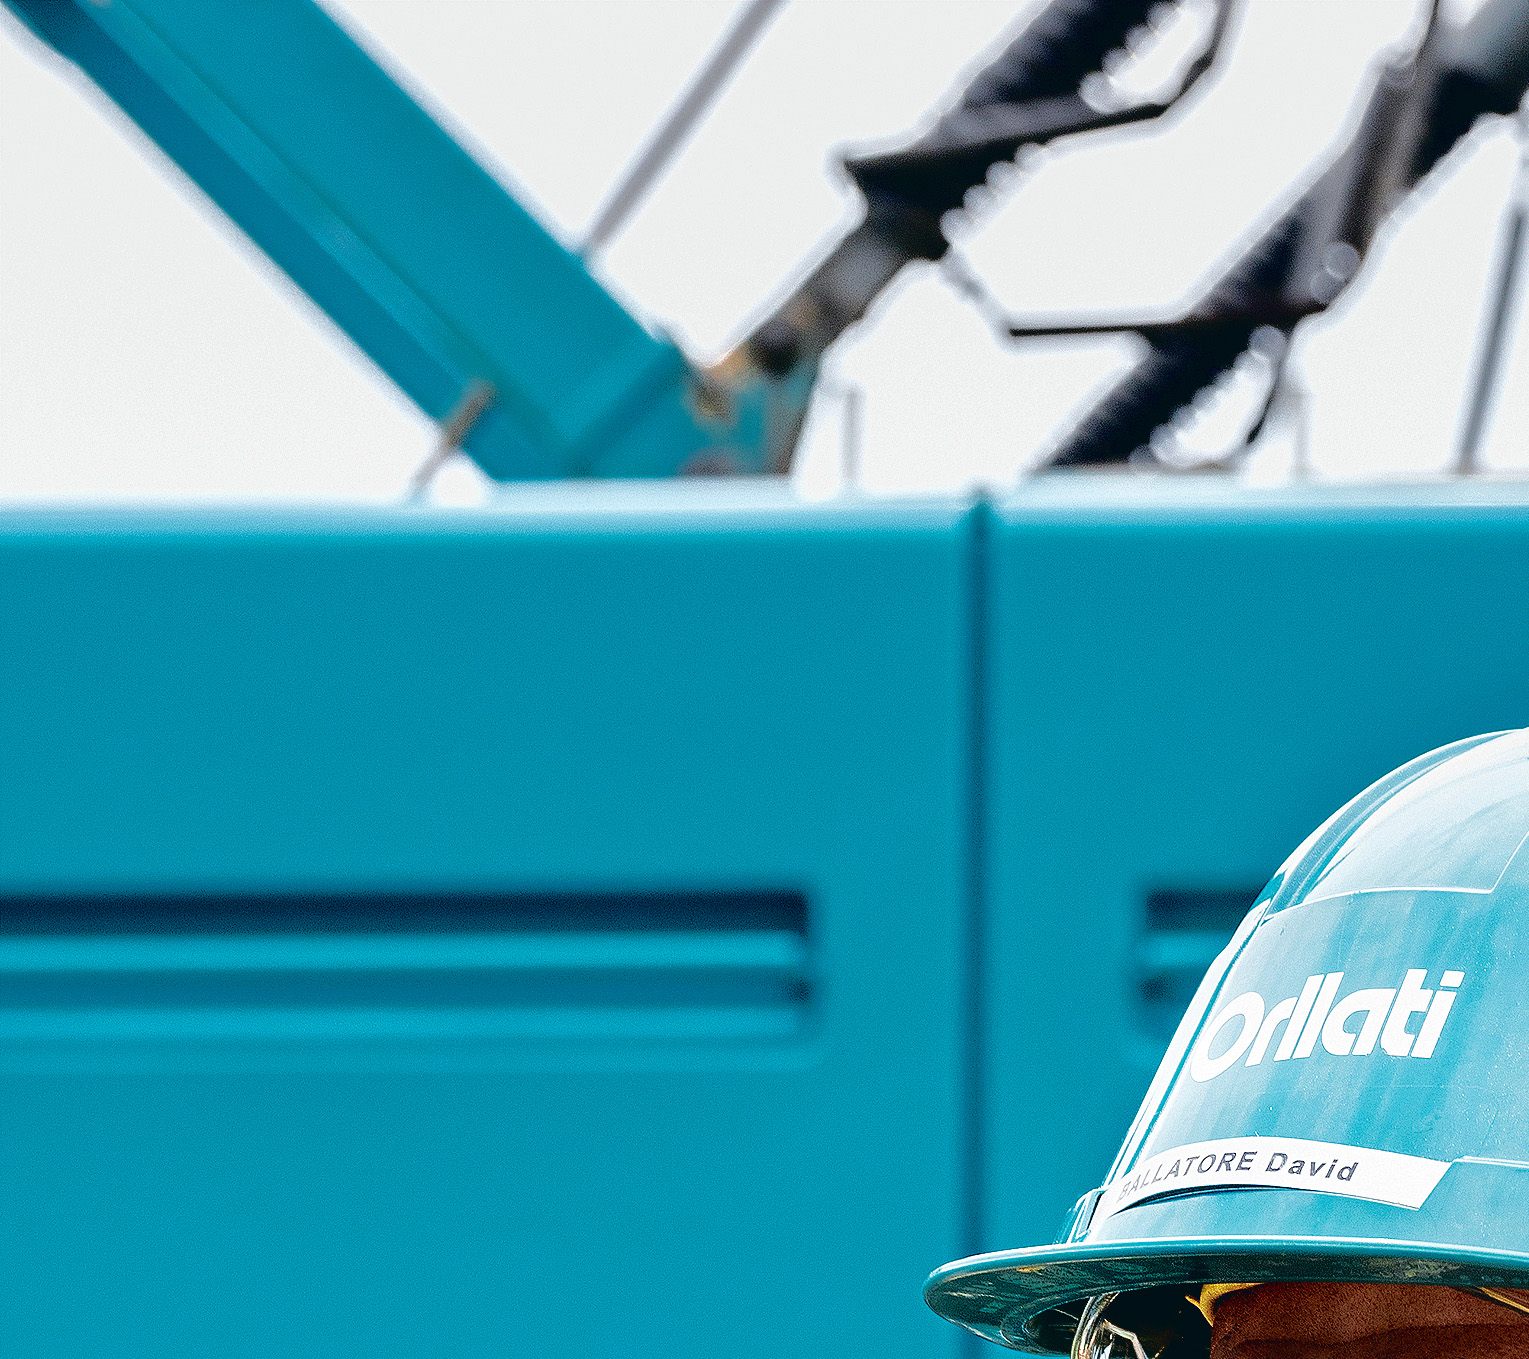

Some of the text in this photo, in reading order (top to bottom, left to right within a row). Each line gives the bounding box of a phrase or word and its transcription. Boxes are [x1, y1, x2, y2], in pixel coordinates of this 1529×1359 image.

[1190, 968, 1466, 1083] Orlati
[1117, 1150, 1360, 1202] BALLATORE David
